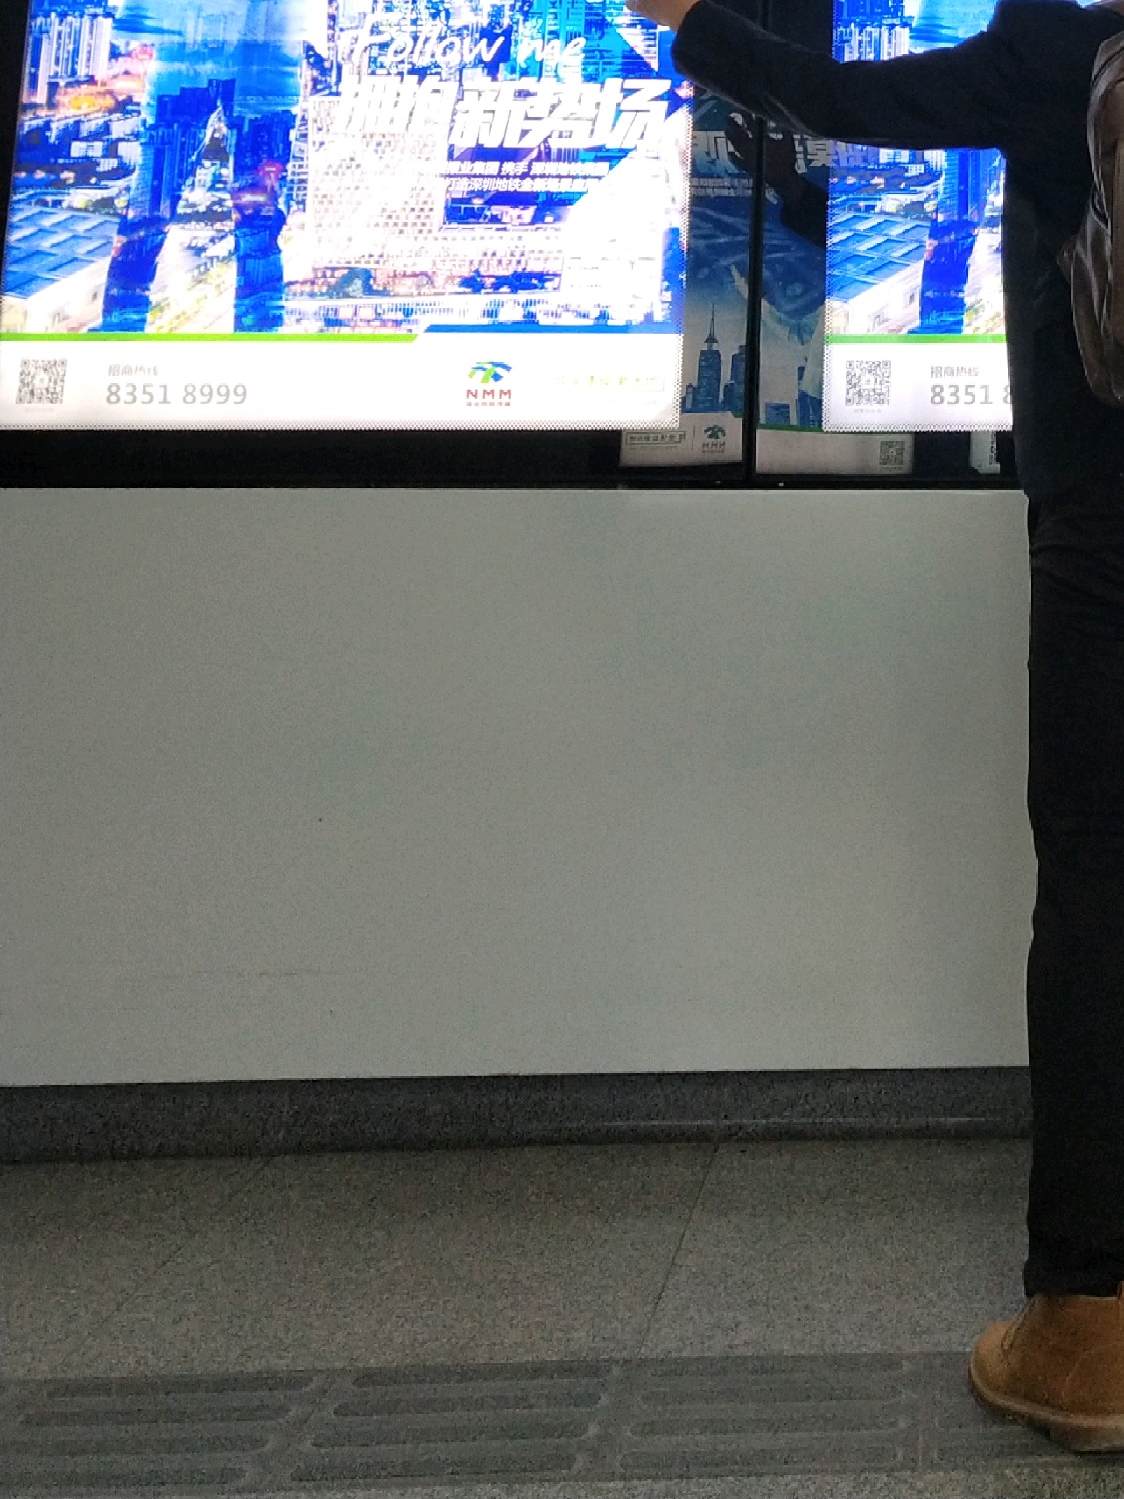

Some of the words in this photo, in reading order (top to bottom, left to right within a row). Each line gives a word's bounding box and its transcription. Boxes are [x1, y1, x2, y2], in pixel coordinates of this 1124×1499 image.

[350, 13, 505, 67] Follow
[517, 36, 587, 67] me
[105, 383, 171, 405] 8351
[182, 384, 248, 406] 8999
[466, 389, 511, 400] NMM
[930, 384, 993, 405] 8351
